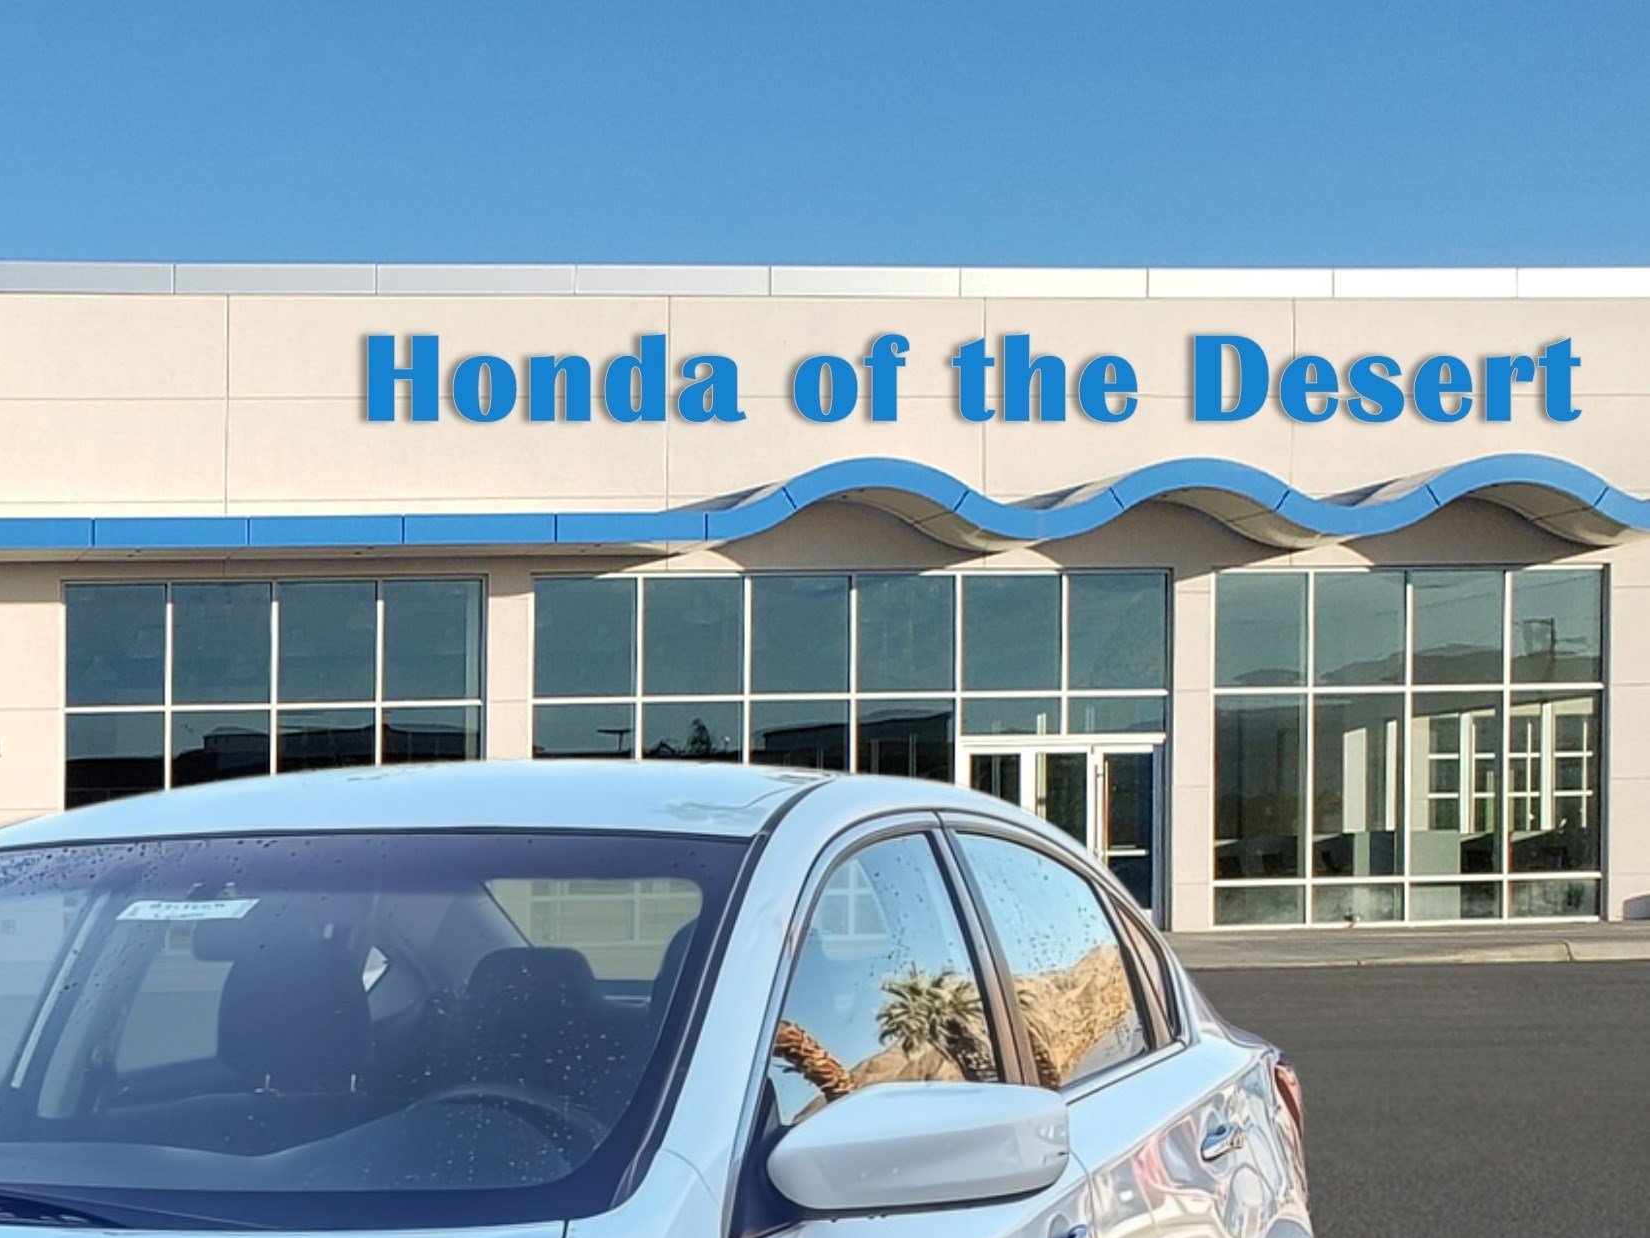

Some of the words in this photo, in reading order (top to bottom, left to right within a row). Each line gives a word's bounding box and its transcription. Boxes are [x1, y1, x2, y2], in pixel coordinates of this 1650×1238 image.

[366, 334, 747, 424] Honda
[793, 333, 910, 424] of
[950, 334, 1139, 424] the
[1193, 335, 1582, 424] Desert
